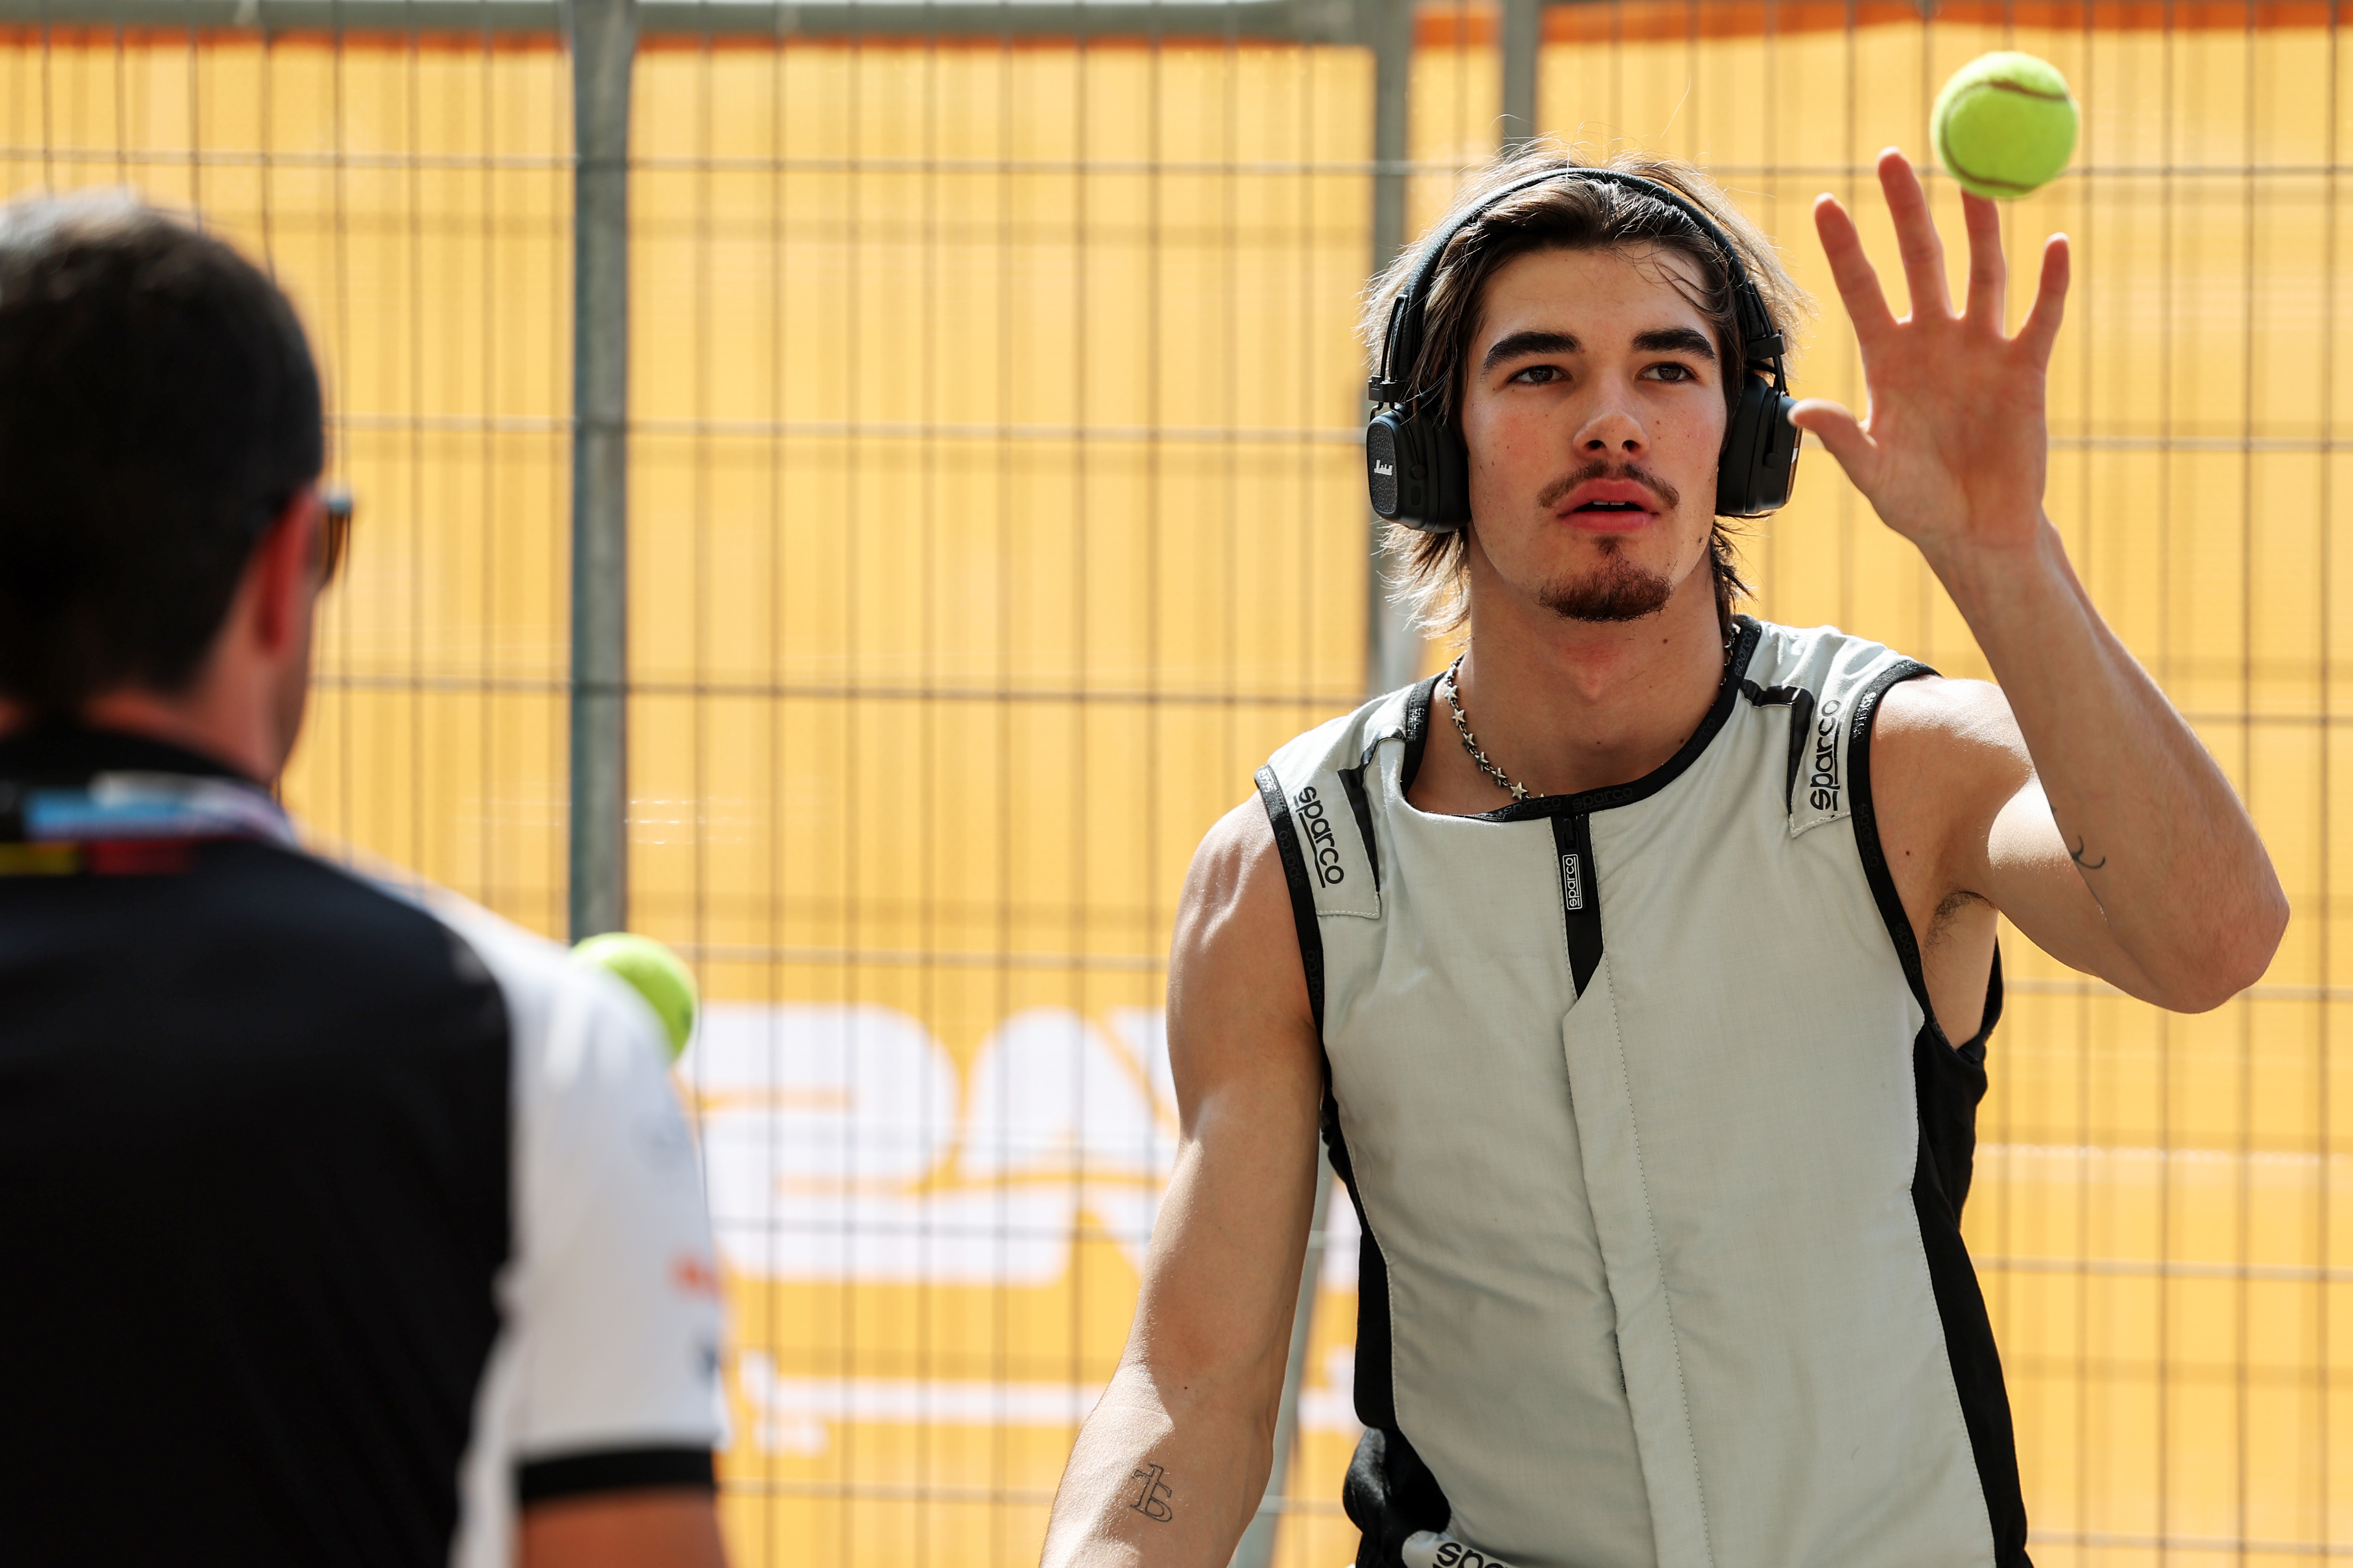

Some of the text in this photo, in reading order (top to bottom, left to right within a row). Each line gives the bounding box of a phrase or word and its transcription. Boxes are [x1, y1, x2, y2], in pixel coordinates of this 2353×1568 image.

[1735, 631, 1753, 676] sparco
[1680, 718, 1715, 764] sparco
[1810, 700, 1842, 810] sparco
[1504, 797, 1562, 814] sparco
[1572, 787, 1633, 811] sparco
[1278, 830, 1304, 888] sparco
[1295, 786, 1344, 885] sparco
[1855, 803, 1879, 868] sparco
[1565, 857, 1580, 907] sparco
[1895, 923, 1920, 975] sparco
[1306, 950, 1323, 1011] sparco
[1437, 1543, 1508, 1568] sp
